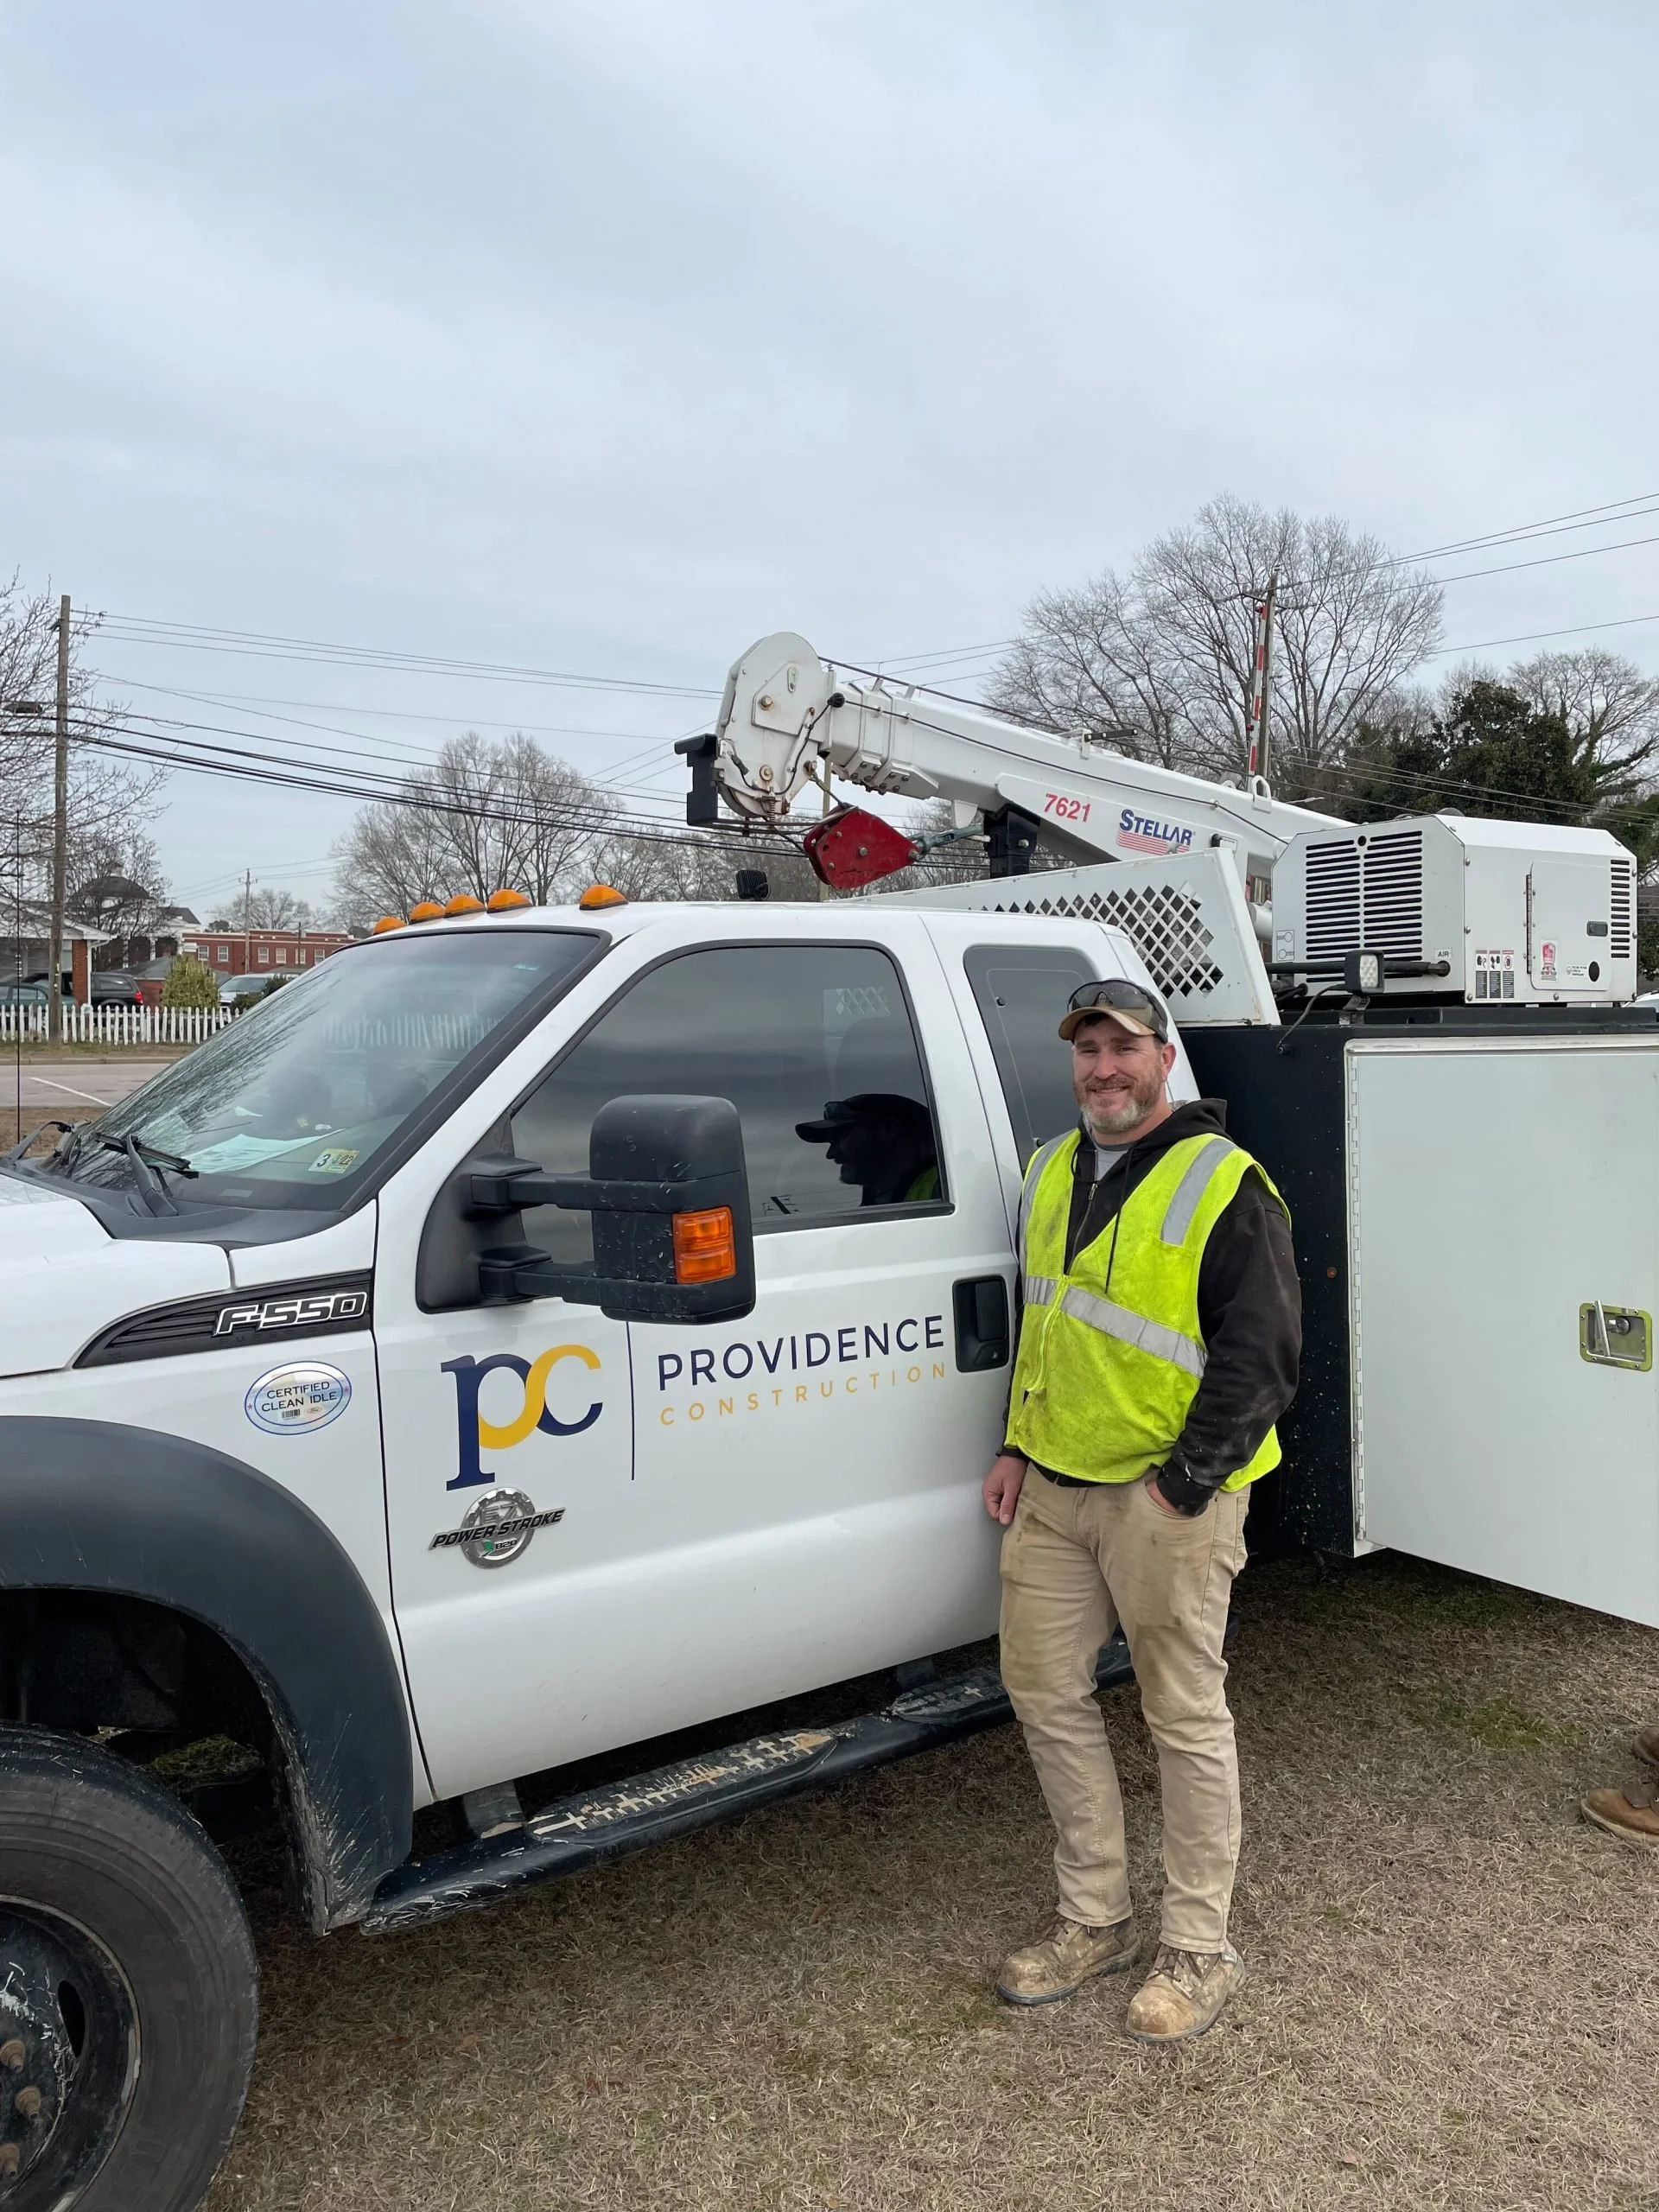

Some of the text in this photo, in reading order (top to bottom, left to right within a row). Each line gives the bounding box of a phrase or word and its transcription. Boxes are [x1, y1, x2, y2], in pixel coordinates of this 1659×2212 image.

[1044, 793, 1091, 822] 7621
[1119, 809, 1193, 846] STELLAR
[316, 1154, 331, 1166] 3
[215, 1292, 367, 1335] F-550
[658, 1315, 944, 1391] PROVIDENCE
[261, 1391, 337, 1412] CLEAN IDLE
[266, 1381, 330, 1399] CERTIFIED
[659, 1362, 945, 1426] CONSTRUCTION
[441, 1344, 603, 1491] pc
[431, 1509, 566, 1548] POWER STROKE
[495, 1539, 518, 1550] B20
